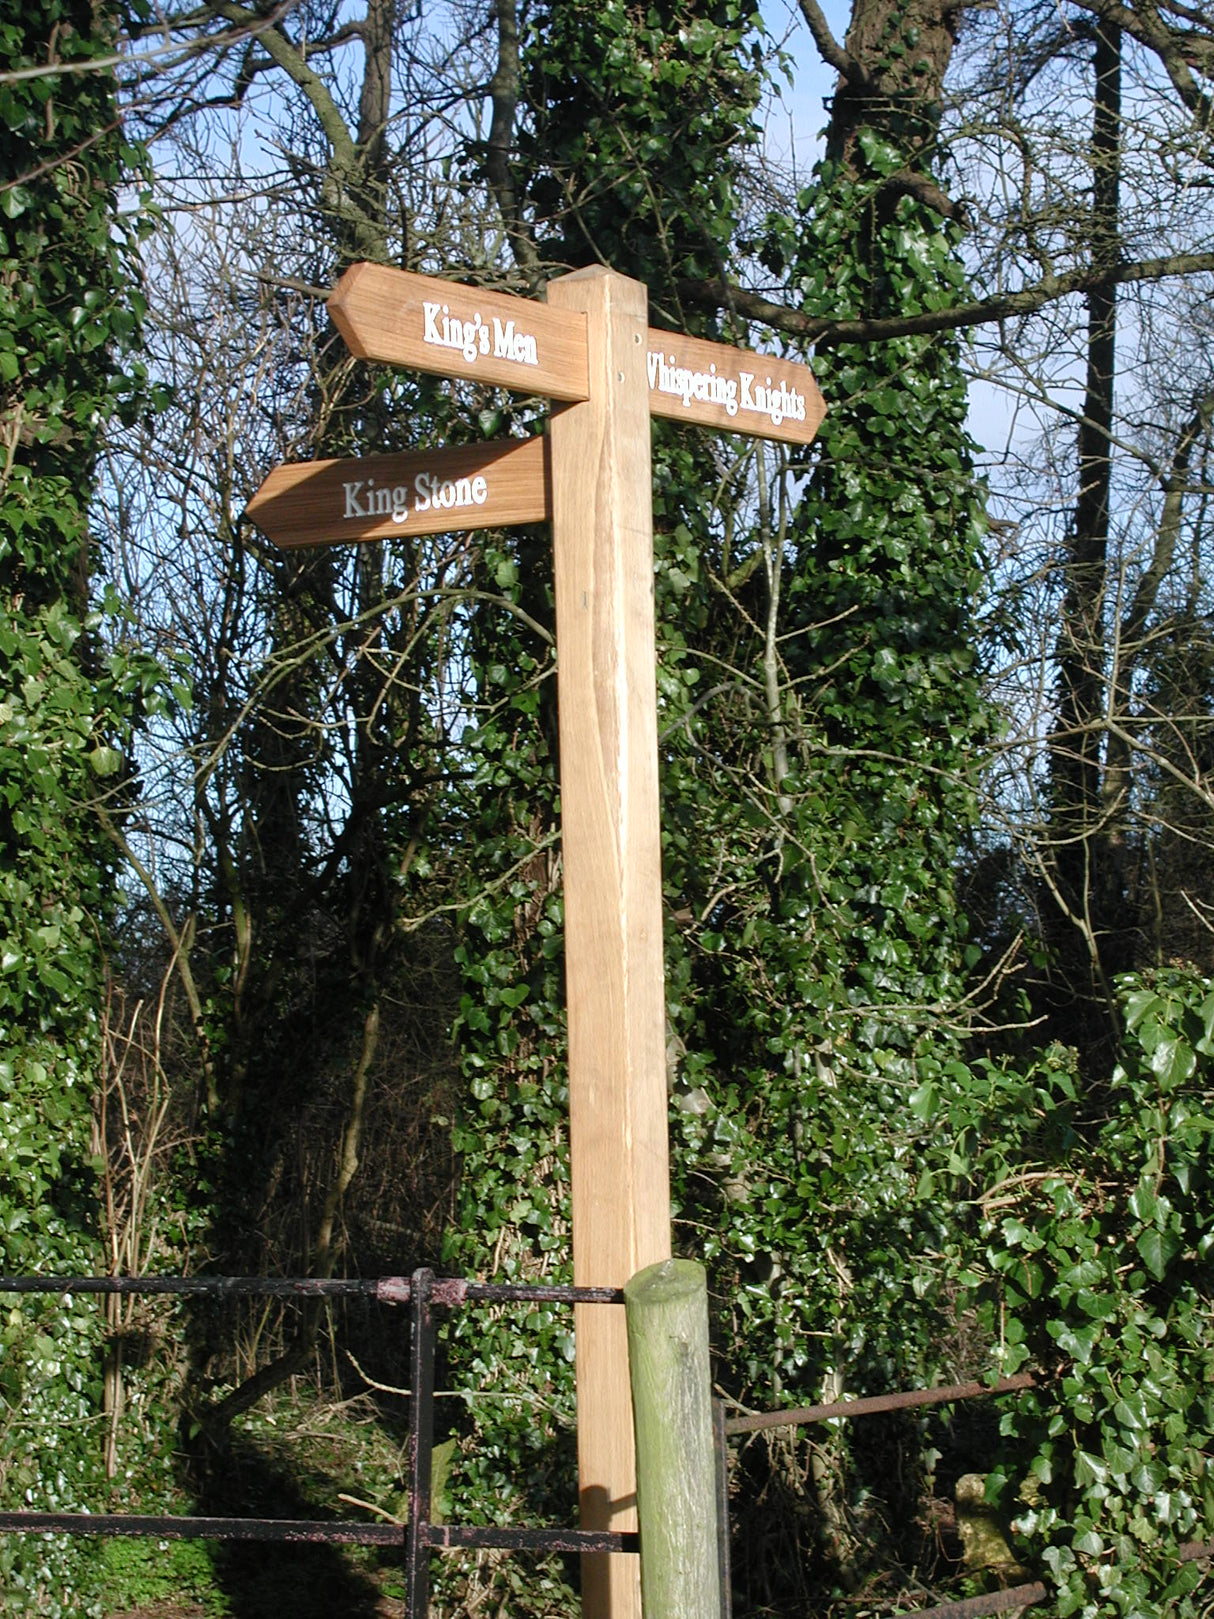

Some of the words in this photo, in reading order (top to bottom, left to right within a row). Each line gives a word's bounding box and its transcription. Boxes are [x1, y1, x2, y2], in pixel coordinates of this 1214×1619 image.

[423, 301, 490, 363] King's
[493, 317, 539, 366] Men
[739, 371, 806, 425] Knights
[342, 478, 409, 523] King
[414, 472, 488, 512] Stone
